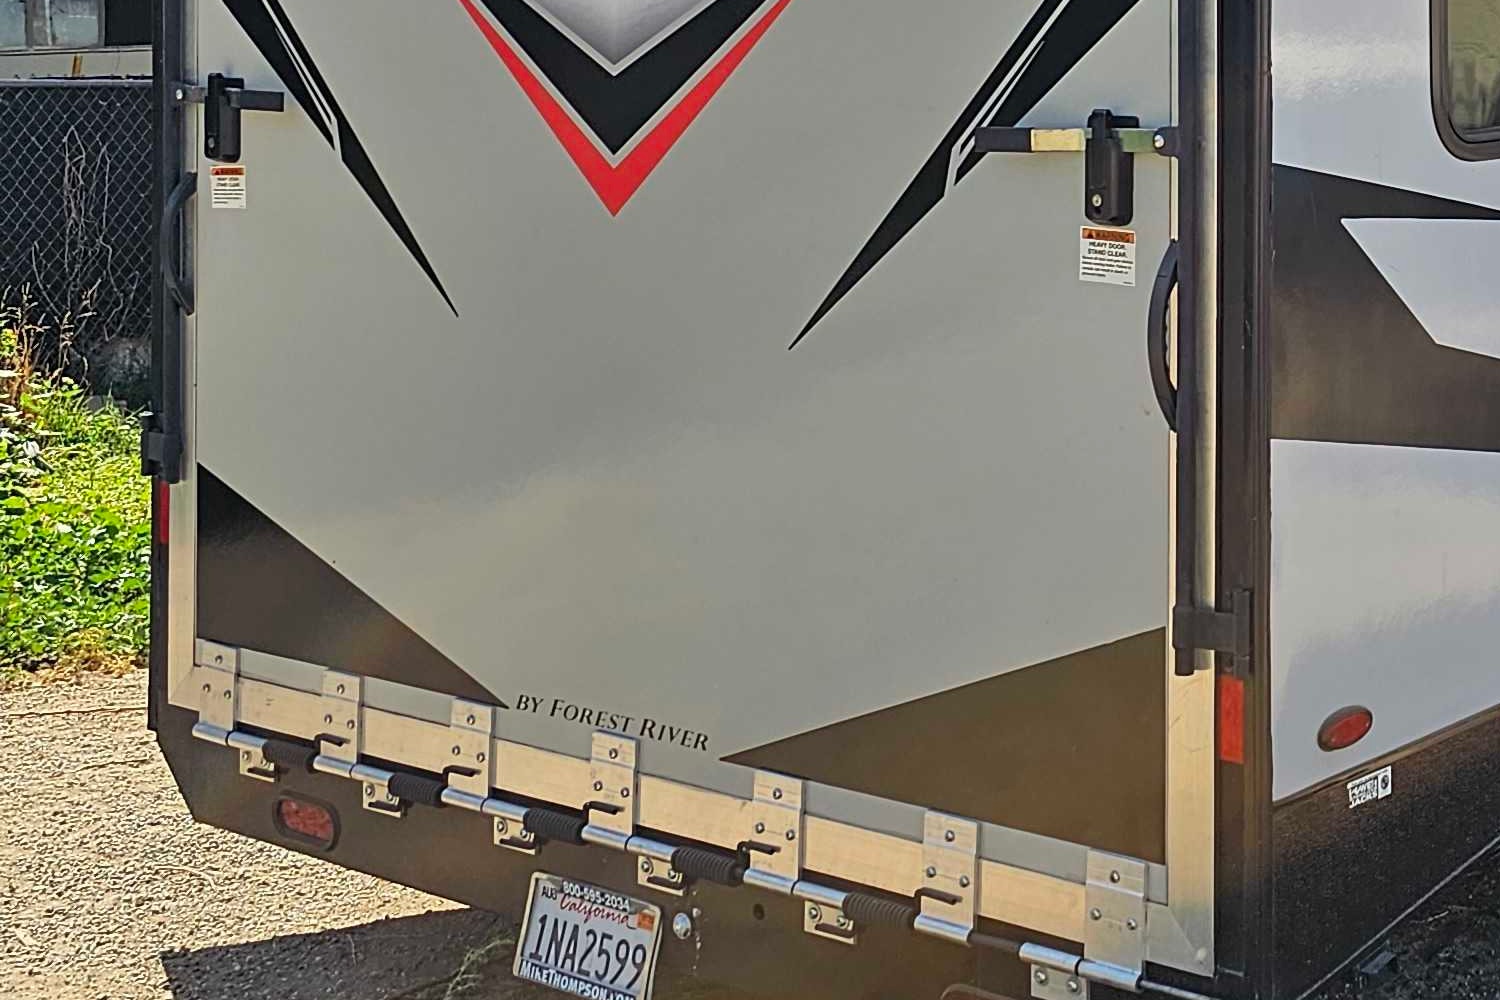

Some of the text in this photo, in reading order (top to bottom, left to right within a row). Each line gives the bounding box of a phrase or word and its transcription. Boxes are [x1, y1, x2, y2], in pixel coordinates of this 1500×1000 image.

[1087, 248, 1106, 256] STAND
[1088, 241, 1107, 249] HEAVY
[516, 694, 708, 751] BY FOREST RIVER
[559, 894, 630, 926] California
[529, 914, 647, 989] 1NA2599
